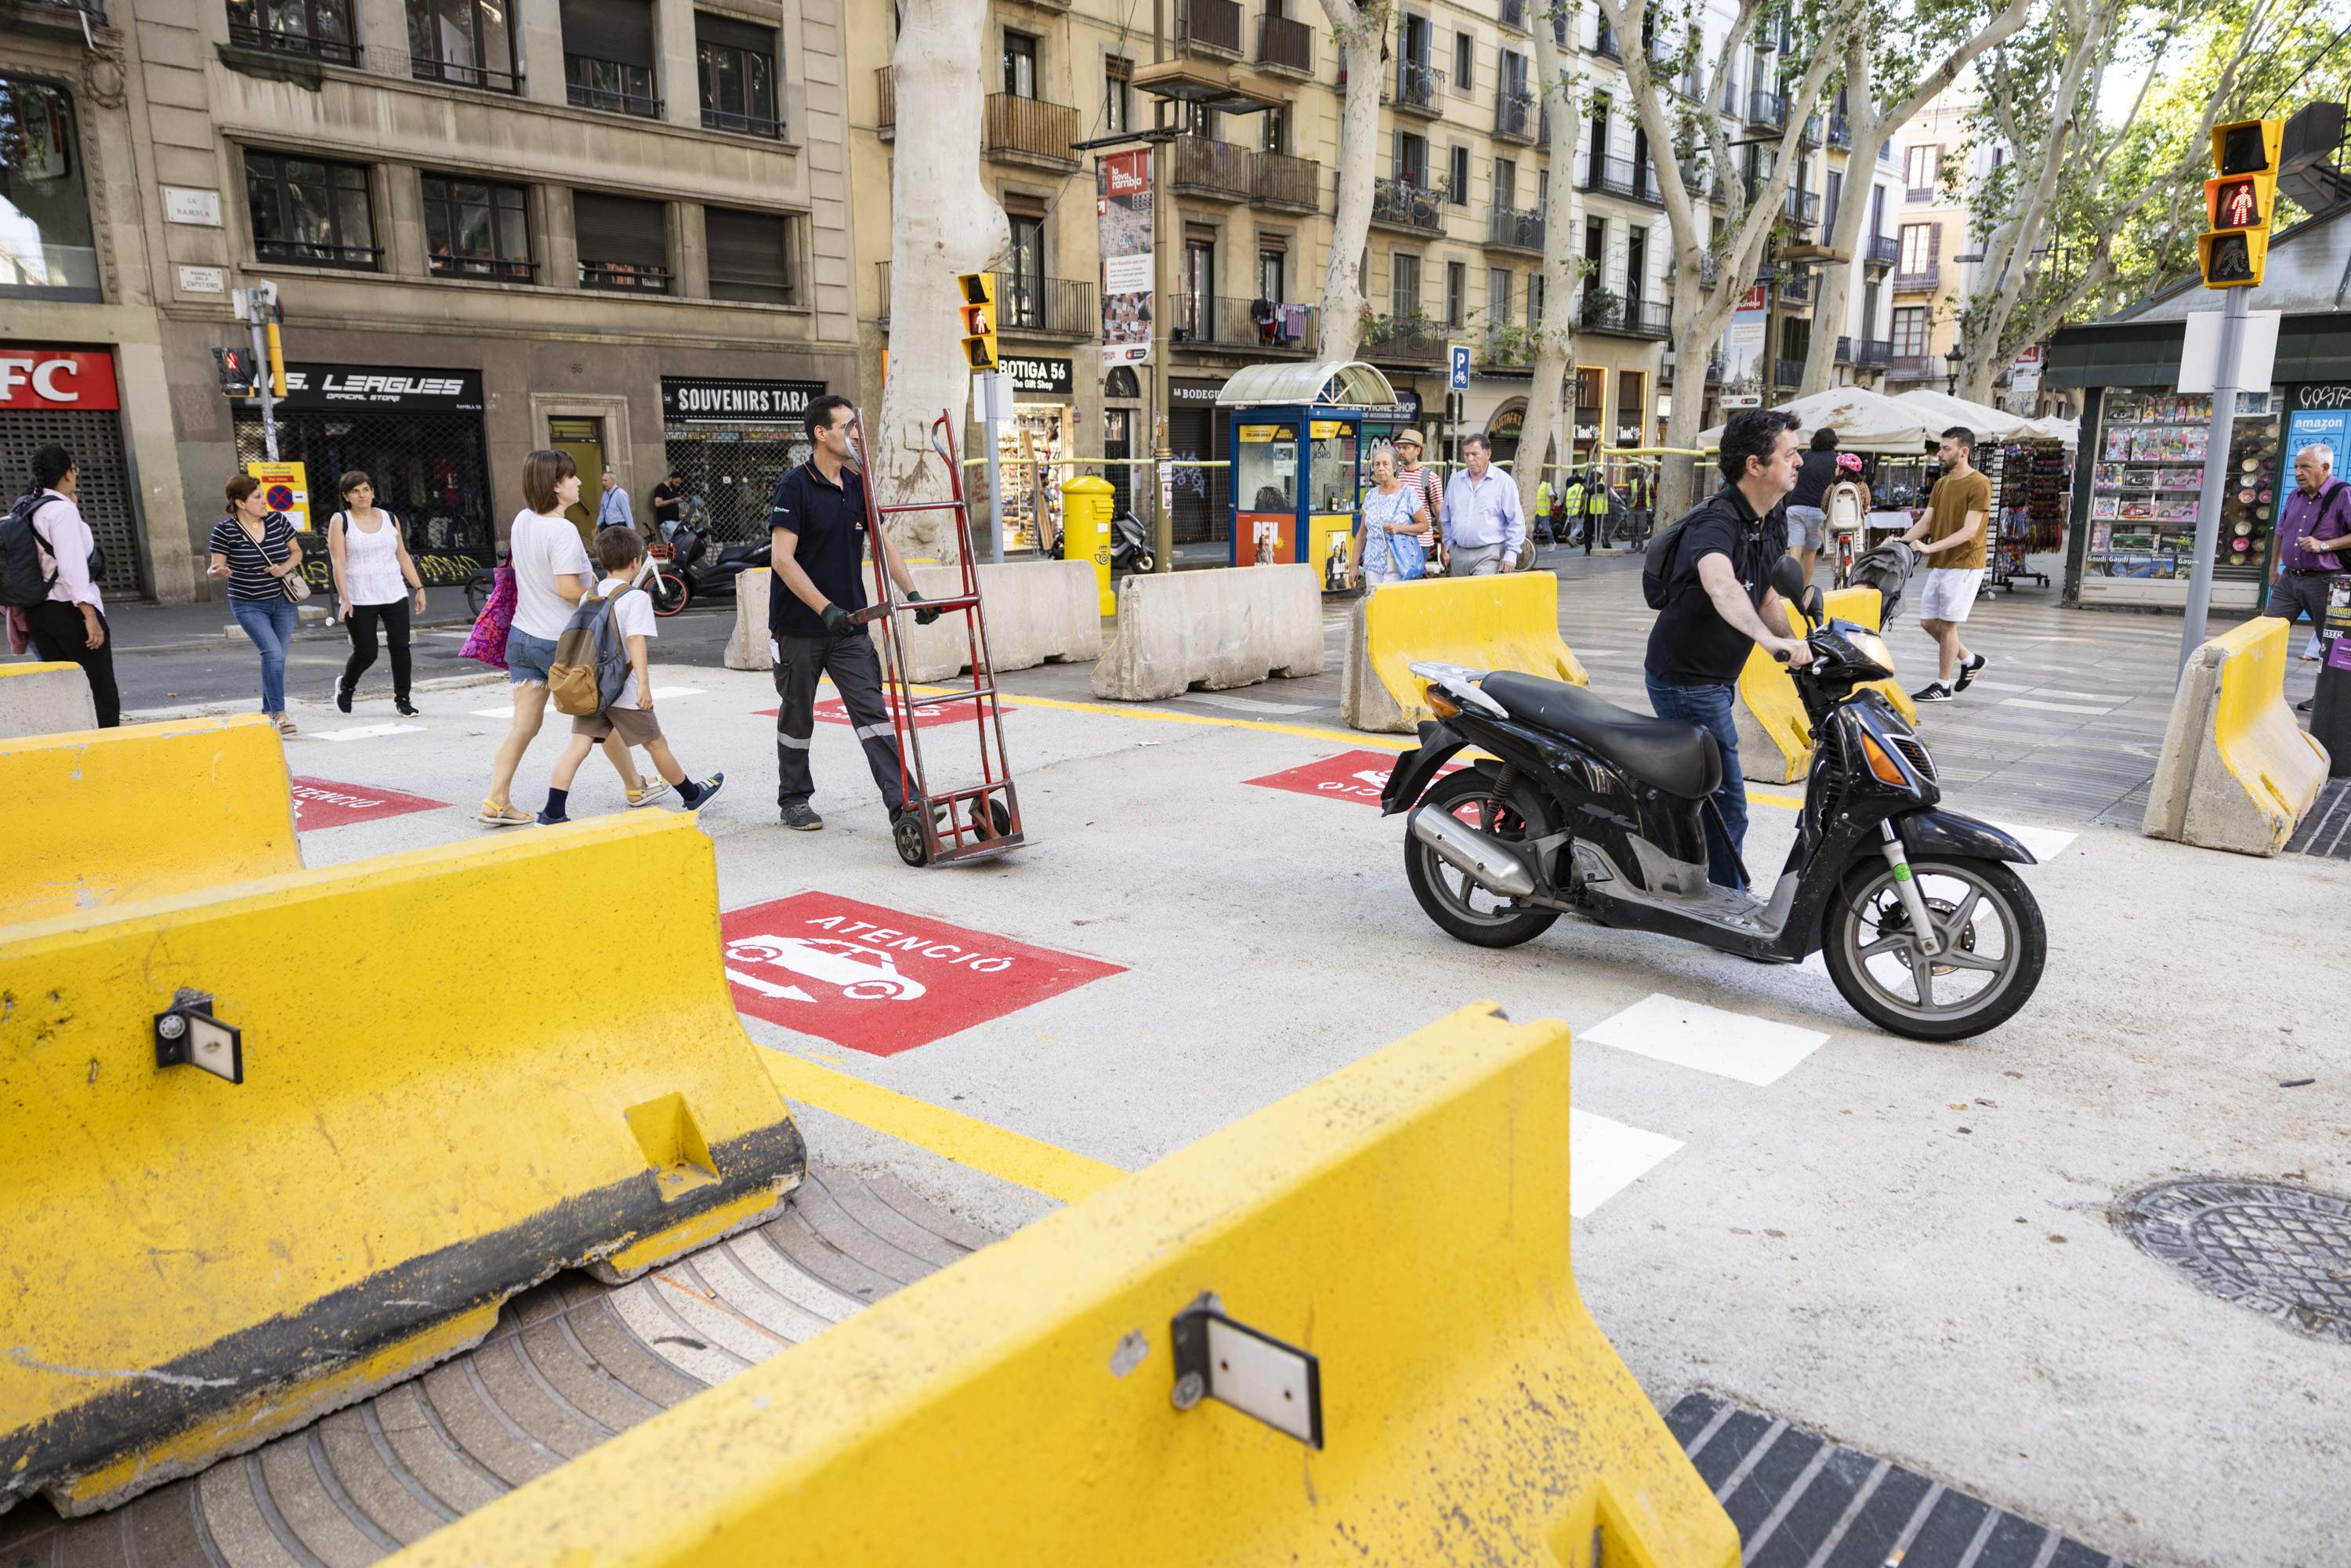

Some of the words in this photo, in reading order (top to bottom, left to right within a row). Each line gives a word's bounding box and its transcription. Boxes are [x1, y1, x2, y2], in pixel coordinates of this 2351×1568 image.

[1112, 166, 1119, 176] la
[1112, 172, 1129, 181] nova
[176, 208, 210, 217] RAMBLA
[1457, 353, 1465, 368] P
[998, 360, 1048, 379] BOTIGA
[1051, 364, 1066, 379] 56
[322, 374, 464, 395] LEAGUES
[1012, 378, 1023, 389] The
[1024, 379, 1036, 389] Gift
[1037, 380, 1053, 391] Shop
[678, 388, 770, 412] SOUVENIRS
[771, 391, 810, 414] TARA
[1393, 402, 1416, 413] SHOP
[2295, 419, 2342, 428] amazon
[806, 915, 1016, 972] ATENCIÓ
